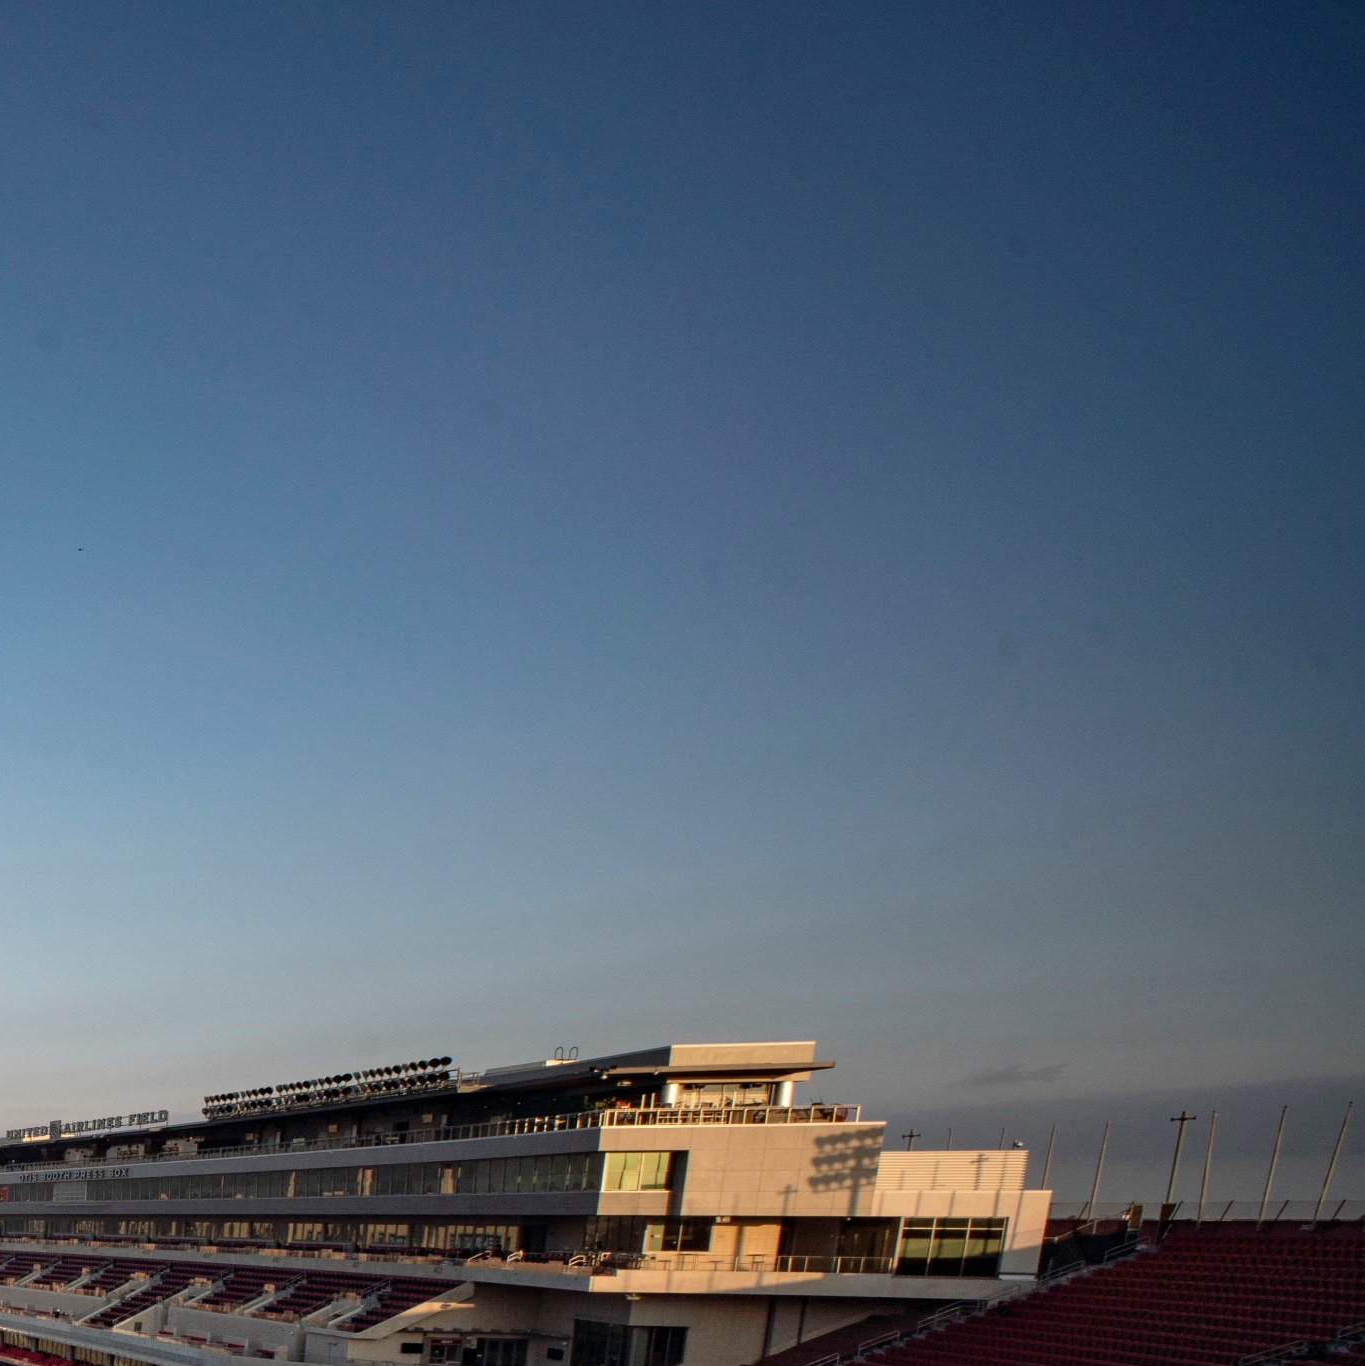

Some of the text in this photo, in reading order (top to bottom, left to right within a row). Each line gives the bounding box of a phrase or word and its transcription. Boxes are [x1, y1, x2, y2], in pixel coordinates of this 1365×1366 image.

[5, 1109, 169, 1141] UNITED AIRLINES FIELD
[19, 1167, 129, 1183] OTIS BOOTH PRESS BOX
